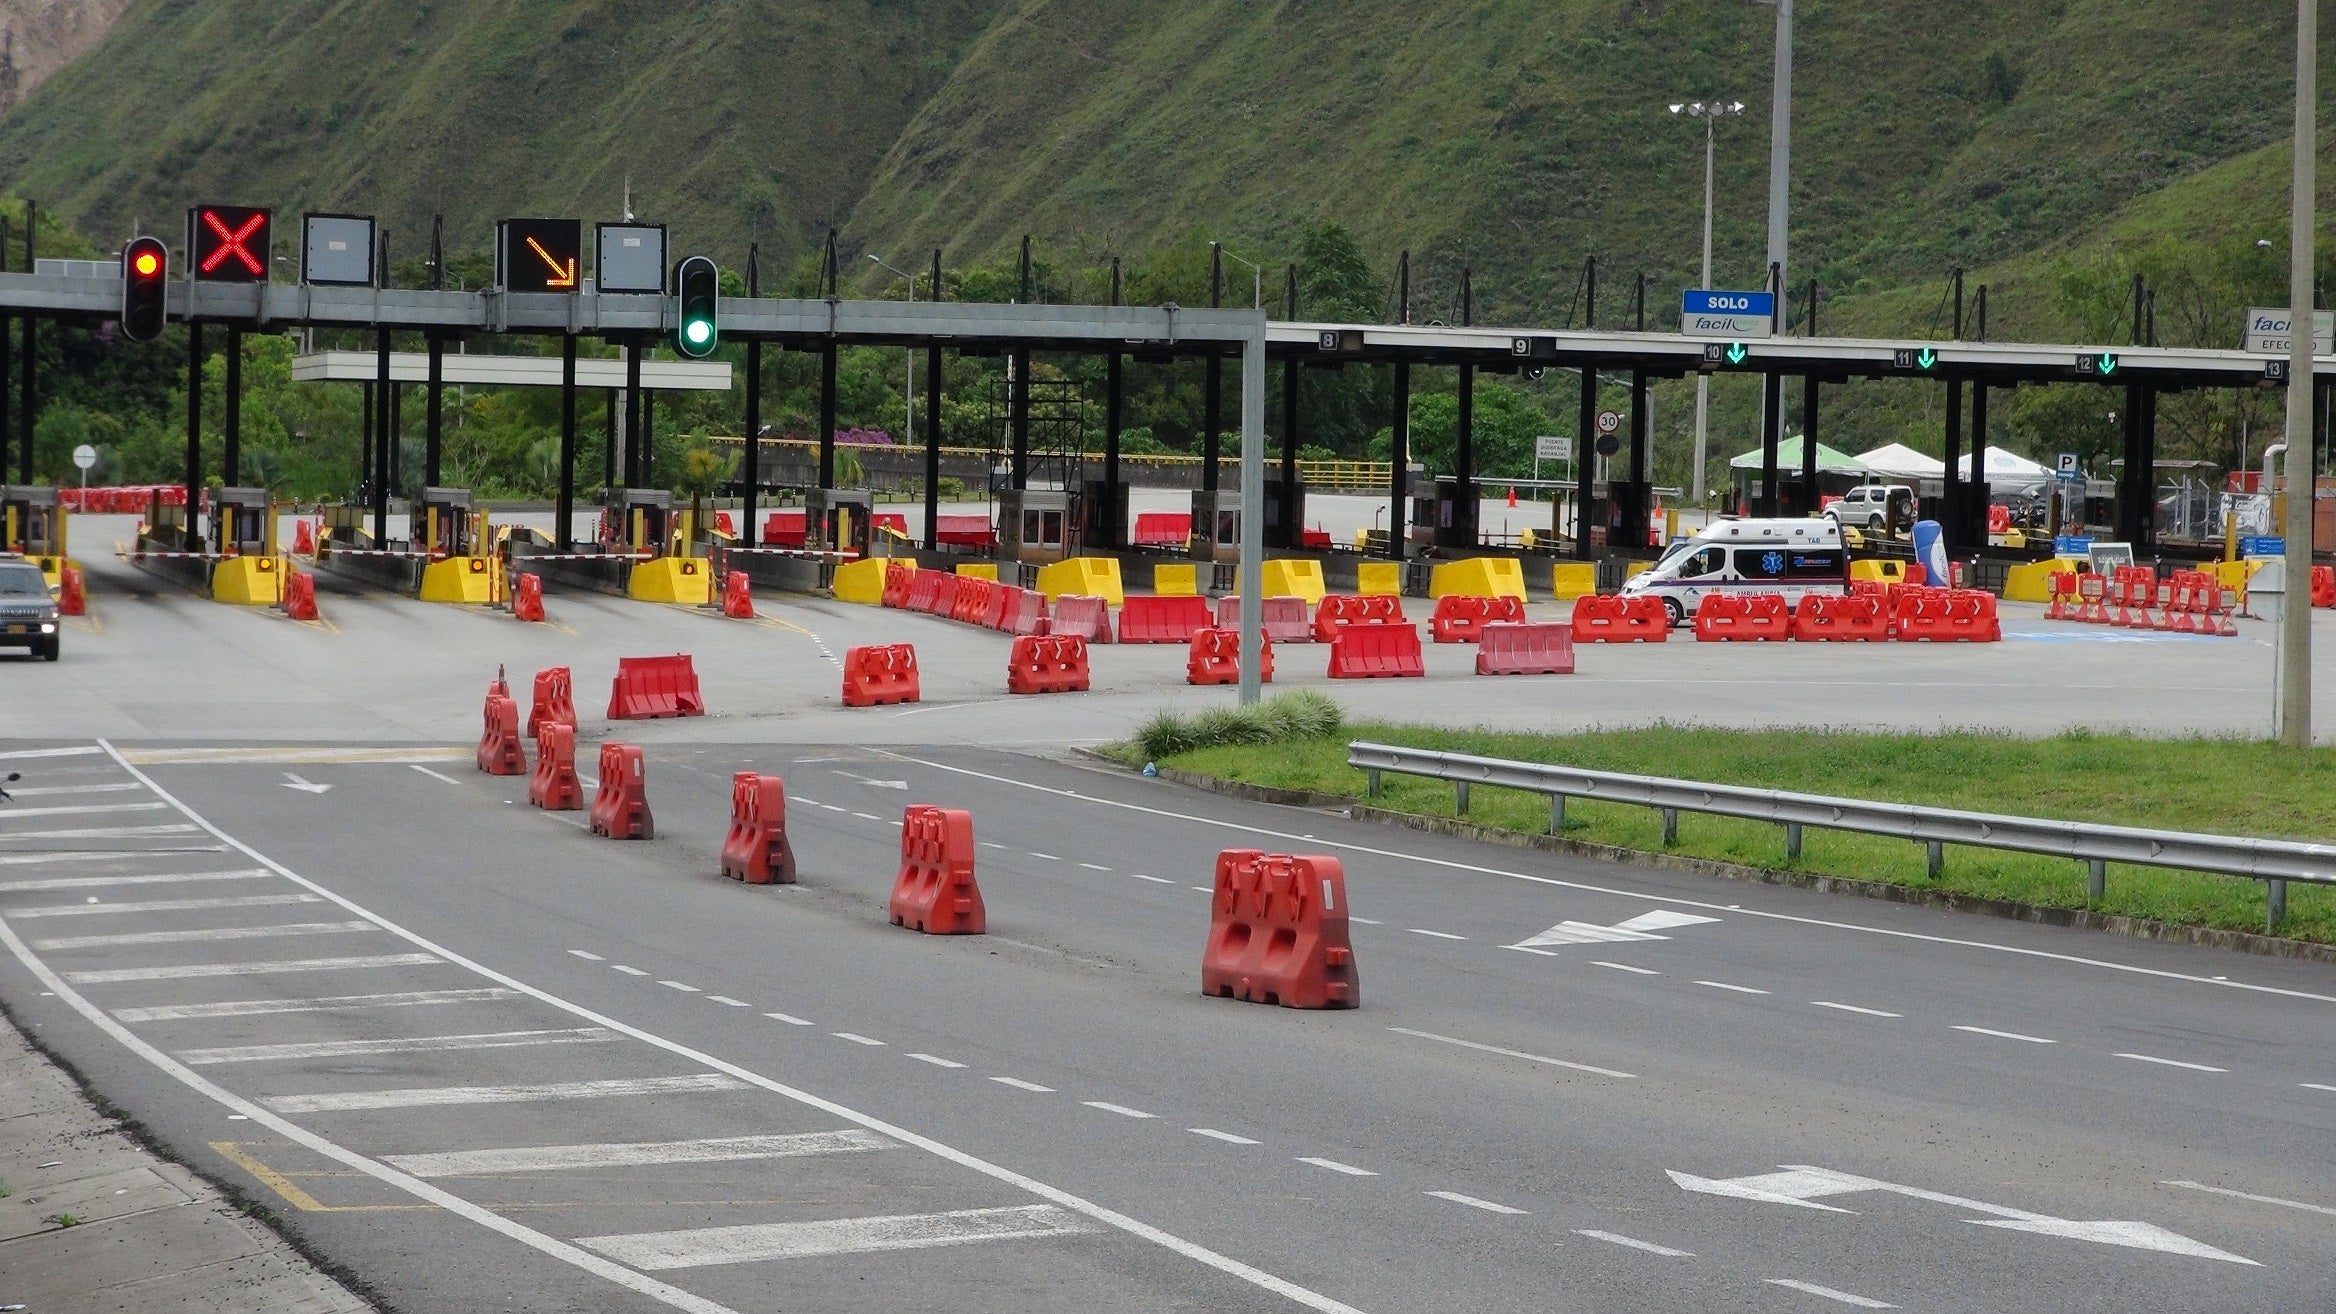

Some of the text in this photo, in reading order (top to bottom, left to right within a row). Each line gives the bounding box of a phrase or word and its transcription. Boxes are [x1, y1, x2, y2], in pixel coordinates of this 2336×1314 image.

[1708, 296, 1749, 310] SOLO
[1323, 333, 1333, 347] 8
[1515, 339, 1527, 353] 9
[1707, 345, 1720, 359] 10
[1898, 351, 1909, 365] 11
[2079, 357, 2091, 370] 12
[2268, 362, 2280, 375] 13
[1601, 416, 1616, 427] 30
[2062, 456, 2072, 469] P
